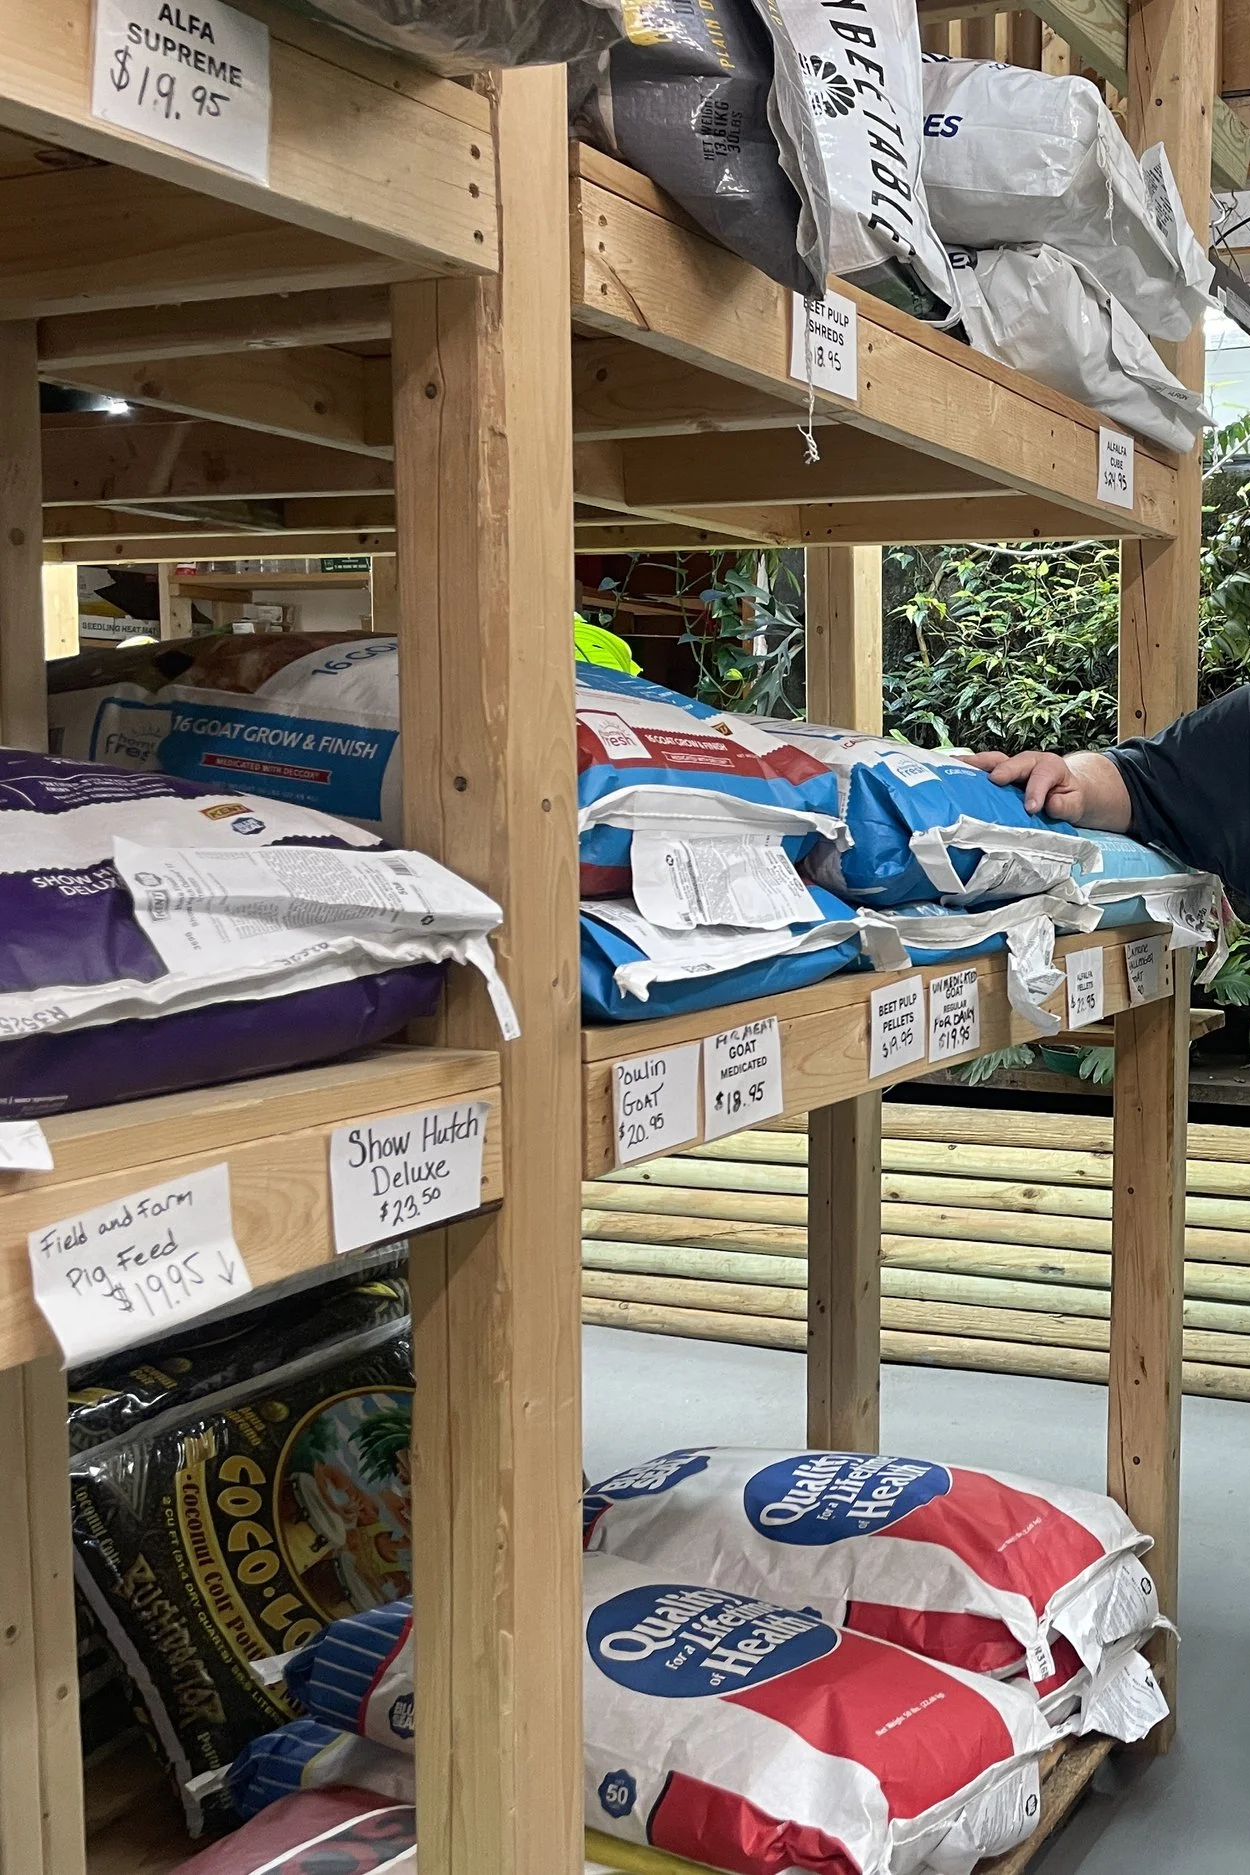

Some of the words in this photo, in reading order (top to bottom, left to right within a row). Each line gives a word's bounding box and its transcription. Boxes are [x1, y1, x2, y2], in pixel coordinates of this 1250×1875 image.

[158, 3, 215, 45] ALFA
[127, 22, 243, 88] SUPREME
[110, 45, 230, 120] $19.95
[808, 319, 844, 346] SHREDS
[828, 307, 849, 327] PULP
[121, 624, 141, 634] HEAT
[172, 714, 193, 733] 16
[192, 716, 245, 739] GOAT
[243, 725, 303, 749] GROW
[302, 733, 318, 751] &
[318, 734, 379, 759] FINISH
[215, 757, 260, 771] MEDICATED
[31, 874, 91, 889] SHOW
[878, 1000, 898, 1017] BEET
[899, 993, 918, 1010] PULP
[943, 1000, 967, 1013] REGULAR
[946, 985, 964, 999] GOAT
[882, 1012, 915, 1033] PELLETS
[729, 1039, 757, 1059] GOAT
[721, 1056, 768, 1079] MEDICATED
[714, 1081, 765, 1115] $18.95
[349, 1129, 410, 1167] Show
[423, 1107, 478, 1152] Hutch
[618, 1113, 665, 1149] $20.95
[371, 1160, 449, 1196] Deluxe
[40, 1221, 88, 1259] Field
[98, 1205, 133, 1235] and
[137, 1190, 193, 1219] Farm
[379, 1187, 441, 1226] $23.50
[66, 1265, 115, 1297] Pig
[117, 1228, 178, 1272] Feed
[112, 1252, 205, 1316] $19.95
[759, 1454, 848, 1526] Quality
[838, 1455, 898, 1503] Lifetime
[847, 1456, 932, 1519] Health
[599, 1588, 720, 1662] Quality
[679, 1599, 784, 1651] Lifetime
[665, 1651, 688, 1671] For
[684, 1643, 696, 1656] a
[700, 1614, 820, 1678] Health
[709, 1672, 726, 1686] of
[605, 1783, 629, 1804] 50
